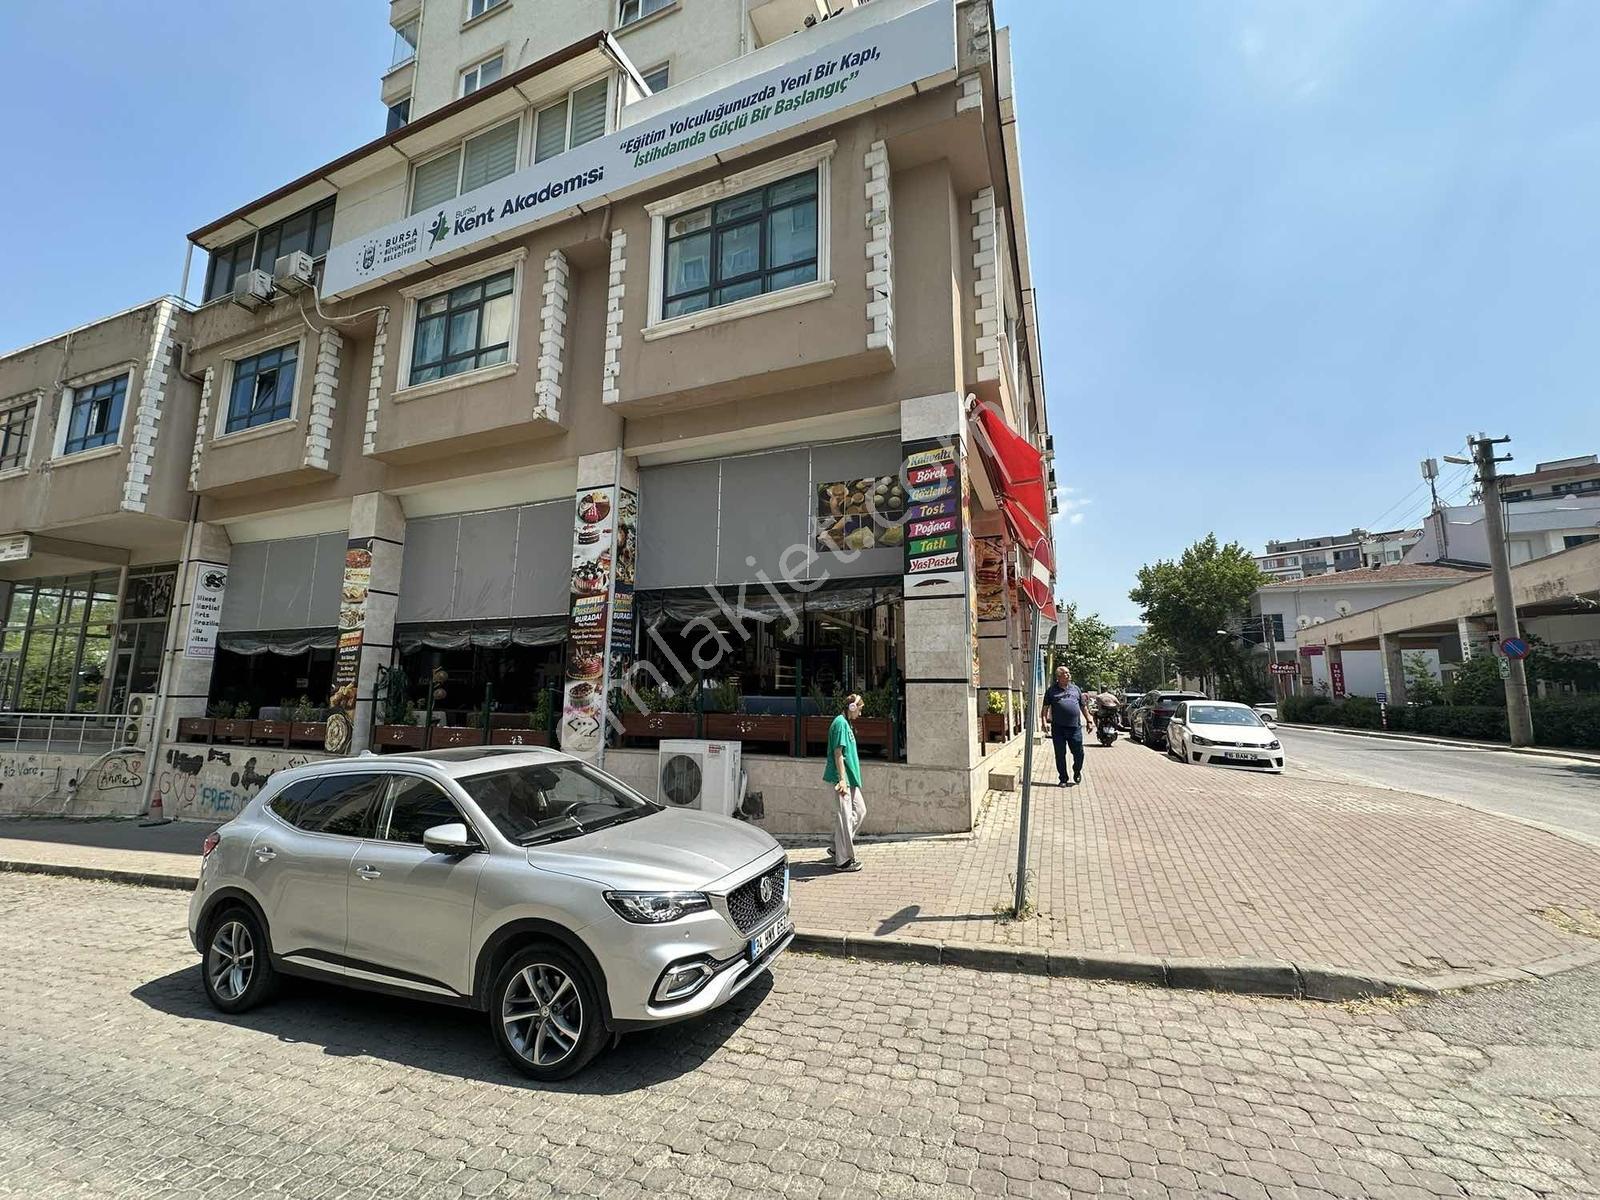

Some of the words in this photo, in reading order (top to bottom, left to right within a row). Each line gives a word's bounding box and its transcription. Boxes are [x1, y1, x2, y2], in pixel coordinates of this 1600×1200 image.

[669, 85, 775, 137] Yolculuğunuzda
[780, 68, 812, 94] Yeni
[813, 60, 838, 81] Bir
[839, 46, 881, 71] Kapı,
[633, 130, 706, 168] İstihdamda
[709, 114, 748, 140] Güçlü
[750, 106, 773, 125] Bir
[453, 206, 495, 235] Kent
[500, 165, 604, 218] Akademisi
[455, 205, 477, 219] Bursa
[385, 228, 418, 248] BURSA
[916, 466, 947, 483] Börek
[920, 503, 945, 517] Tost
[915, 520, 951, 536] Poğaca
[920, 538, 946, 552] Tatlı
